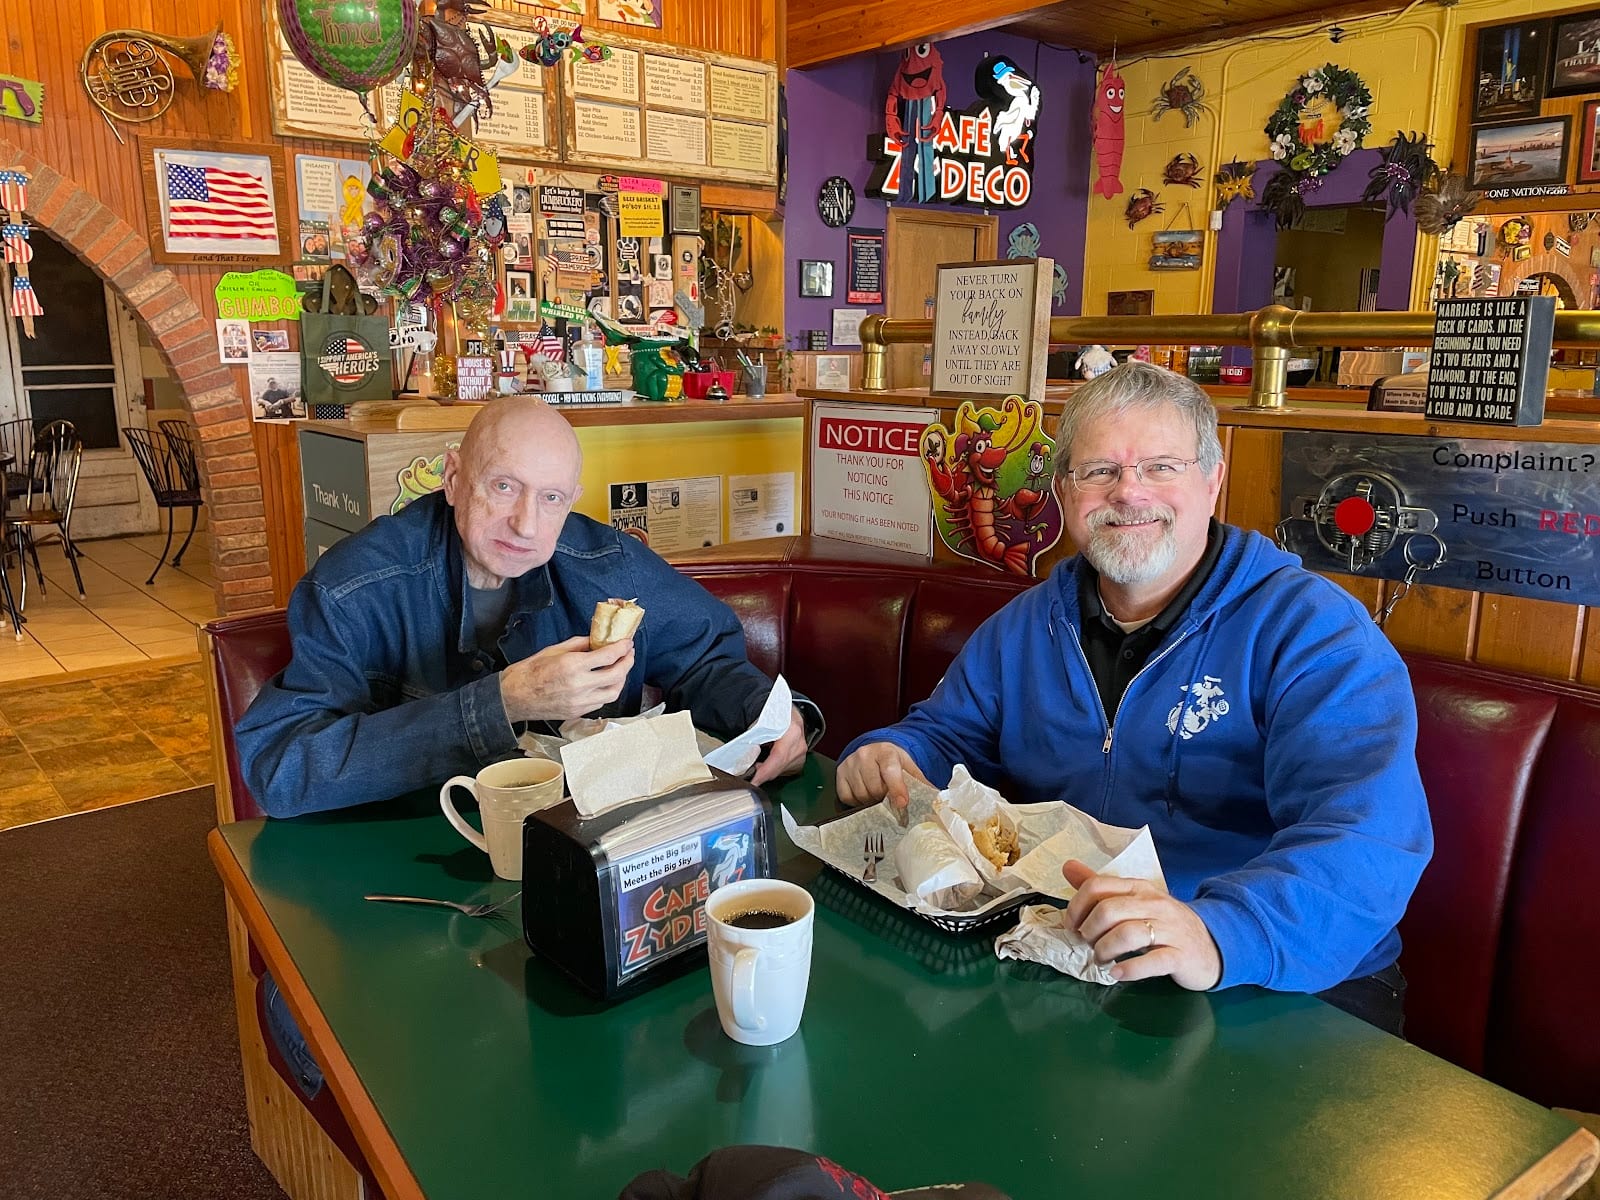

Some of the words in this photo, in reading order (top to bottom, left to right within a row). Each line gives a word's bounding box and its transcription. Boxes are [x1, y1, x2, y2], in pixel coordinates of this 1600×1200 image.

[934, 106, 992, 157] AFÉ
[882, 137, 1030, 206] ZDECO
[1489, 188, 1509, 198] ONE
[1511, 186, 1547, 197] NATION
[956, 274, 988, 286] NEVER
[991, 273, 1018, 284] TURN
[950, 290, 976, 300] YOUR
[979, 289, 1007, 299] BACK
[1008, 288, 1023, 298] ON
[541, 308, 574, 318] WHIRLED
[1438, 303, 1481, 317] MARRIAGE
[1484, 302, 1493, 316] IS
[1496, 302, 1516, 316] LIKE
[1519, 301, 1525, 315] A
[1437, 320, 1456, 333] DECK
[1457, 320, 1466, 333] OF
[1468, 319, 1495, 333] CARDS.
[1497, 319, 1506, 333] IN
[1509, 319, 1524, 333] THE
[949, 330, 990, 341] INSTEAD,
[992, 330, 1019, 340] BACK
[1434, 337, 1471, 350] BEGINNING
[1472, 337, 1484, 350] ALL
[1487, 337, 1501, 350] YOU
[1502, 337, 1521, 350] NEED
[320, 354, 346, 364] SUPPORT
[346, 352, 378, 361] AMERICA'S
[950, 345, 978, 355] AWAY
[980, 345, 1020, 356] SLOWLY
[335, 359, 379, 375] HEROES
[458, 359, 462, 367] A
[464, 359, 483, 367] HOUSE
[484, 359, 491, 367] IS
[945, 360, 971, 370] UNTIL
[975, 360, 999, 370] THEY
[1002, 361, 1021, 371] ARE
[1432, 353, 1441, 366] IS
[1443, 353, 1459, 367] TWO
[1462, 353, 1491, 367] HEARTS
[1493, 354, 1511, 368] AND
[1513, 354, 1519, 368] A
[458, 368, 469, 376] NOT
[471, 368, 476, 376] A
[478, 368, 492, 376] HOME
[950, 374, 968, 384] OUT
[970, 375, 982, 385] OF
[984, 375, 1012, 385] SIGHT
[1430, 369, 1467, 383] DIAMOND.
[1469, 370, 1480, 384] BY
[1483, 371, 1497, 384] THE
[1499, 371, 1516, 386] END,
[459, 377, 484, 386] WITHOUT
[487, 377, 492, 386] A
[543, 394, 559, 403] GOOGLE
[1430, 385, 1445, 398] YOU
[1449, 386, 1472, 400] WISH
[1476, 387, 1493, 401] YOU
[1496, 388, 1516, 402] HAD
[1427, 401, 1432, 414] A
[1435, 402, 1454, 416] CLUB
[1456, 403, 1474, 416] AND
[1475, 404, 1481, 418] A
[1484, 405, 1512, 420] SPADE.
[826, 424, 918, 452] NOTICE
[837, 453, 864, 466] THANK
[866, 456, 883, 468] YOU
[886, 458, 904, 470] FOR
[1432, 447, 1595, 473] Complaint?
[848, 471, 888, 486] NOTICING
[313, 483, 339, 509] Thank
[342, 493, 360, 516] You
[843, 488, 860, 500] THIS
[862, 491, 894, 505] NOTICE
[822, 510, 837, 519] YOUR
[867, 517, 879, 526] HAS
[880, 519, 896, 528] BEEN
[897, 522, 919, 532] NOTED
[1453, 504, 1516, 528] Push
[1539, 509, 1600, 536] RED
[1476, 560, 1572, 591] Button
[622, 860, 649, 875] Where
[651, 854, 665, 864] the
[666, 848, 679, 859] Big
[681, 840, 699, 853] Easy
[624, 876, 647, 888] Meets
[650, 869, 663, 878] the
[664, 862, 677, 873] Big
[678, 856, 692, 867] Sky
[643, 868, 710, 922] CAFÉ
[625, 910, 708, 966] ZYDE
